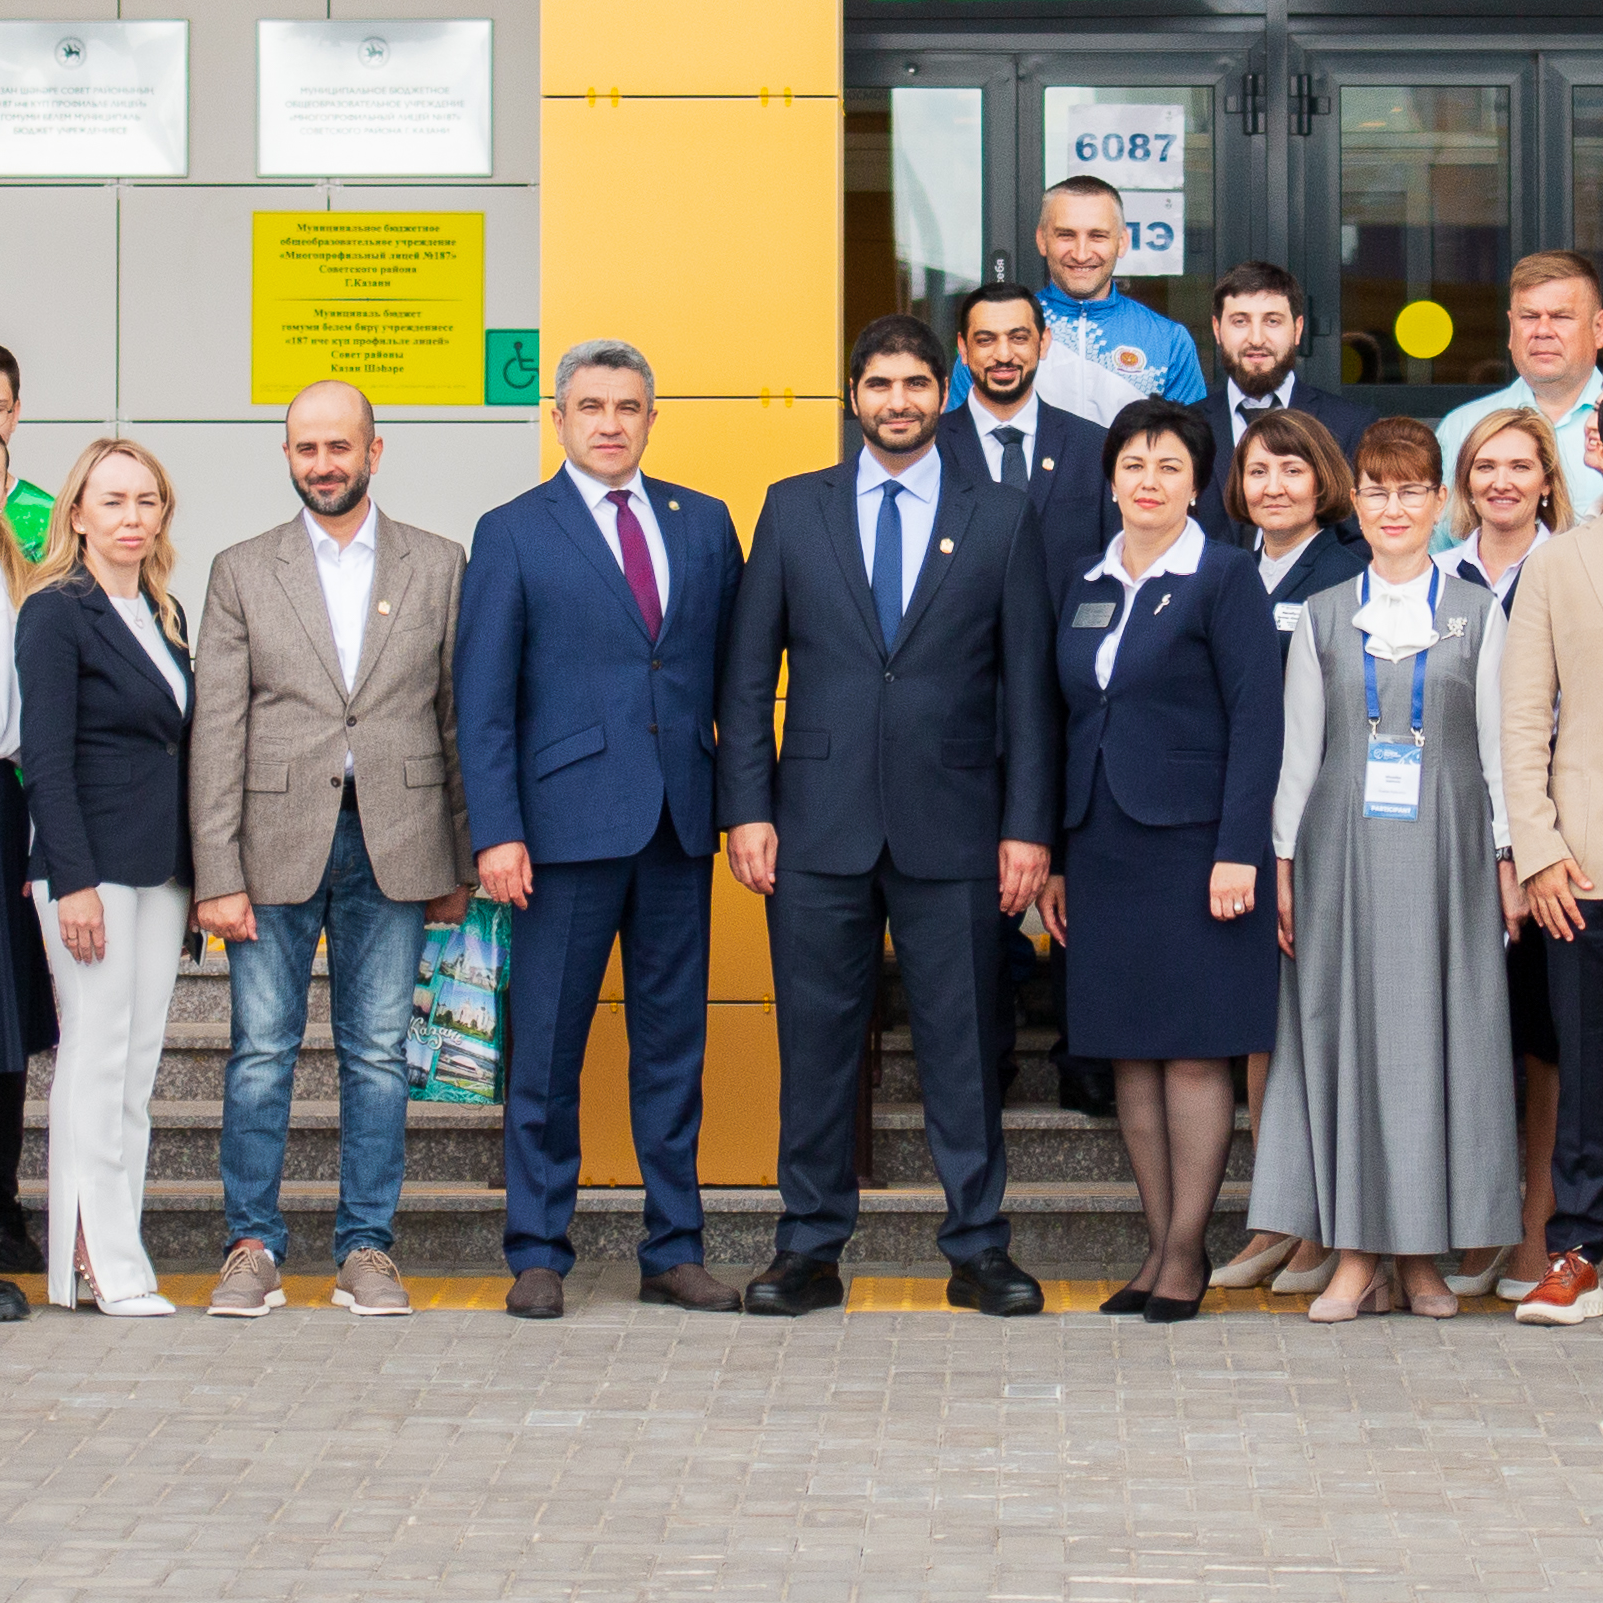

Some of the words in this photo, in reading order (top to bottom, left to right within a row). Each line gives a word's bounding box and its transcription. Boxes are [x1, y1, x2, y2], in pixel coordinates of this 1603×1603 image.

[60, 86, 91, 96] СОВЕТ
[300, 85, 387, 97] МУНИЦИПАЛЬНОЕ
[388, 85, 450, 97] БЮДЖЕТНОЕ
[284, 99, 401, 110] ОБЩЕОБРАЗОВАТЕЛЬНОЕ
[404, 99, 465, 110] УЧРЕЖДЕНИЕ
[299, 126, 362, 136] СОВЕТСКОГО
[1075, 133, 1177, 162] 6087
[297, 223, 382, 234] Муниципальное
[384, 223, 440, 234] бюджетное
[280, 237, 393, 248] общеобразовательное
[395, 238, 457, 249] учреждение
[318, 264, 378, 274] Советского
[380, 265, 417, 275] района
[994, 258, 1005, 283] ебя
[330, 350, 361, 360] Совет
